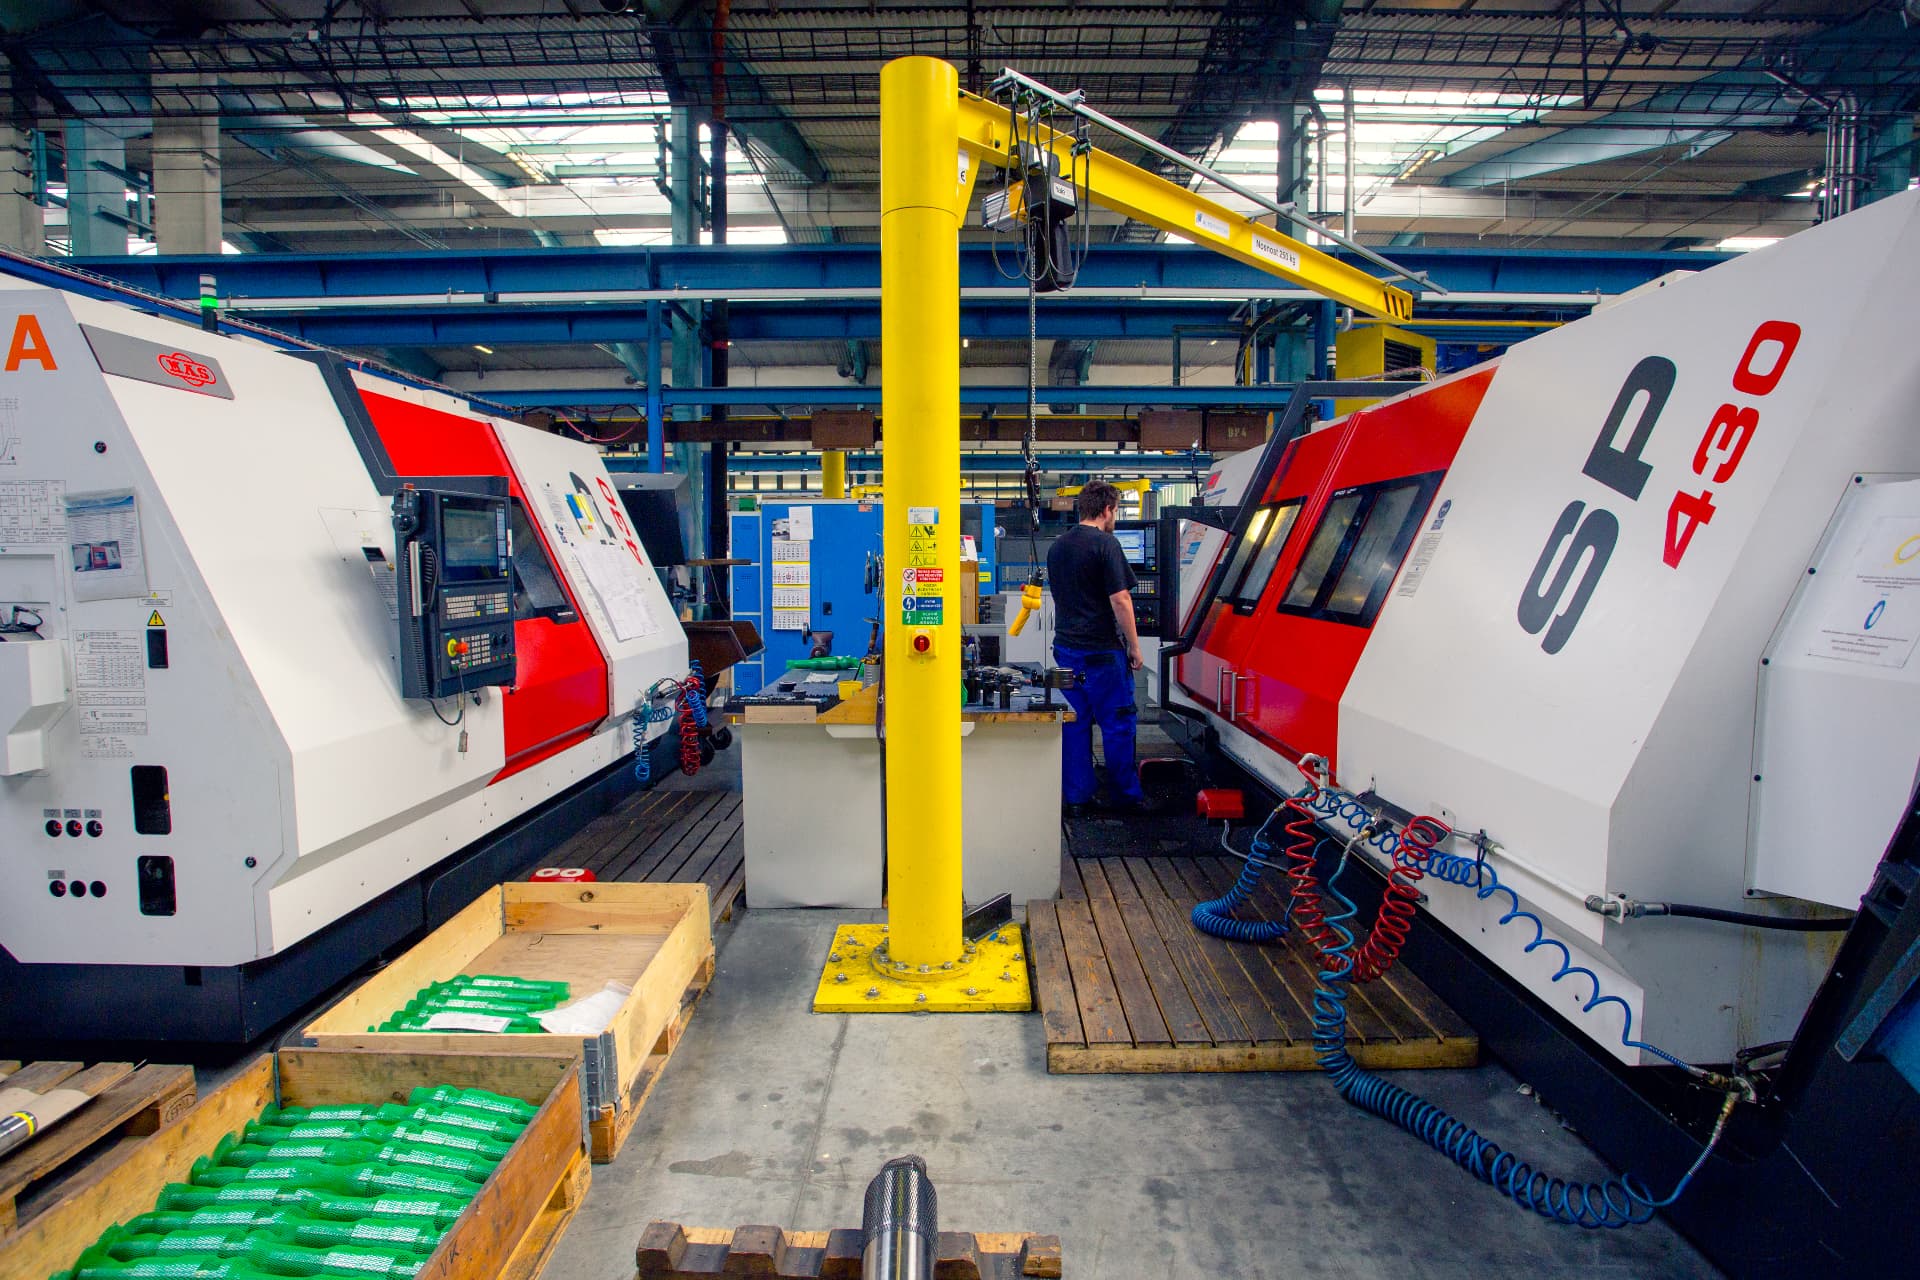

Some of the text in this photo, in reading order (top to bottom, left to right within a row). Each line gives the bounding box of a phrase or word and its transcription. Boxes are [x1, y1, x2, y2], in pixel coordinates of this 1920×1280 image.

[1256, 239, 1296, 266] Nosnost 250 kg
[5, 314, 58, 371] A
[1662, 320, 1802, 570] 430
[596, 476, 643, 566] 430
[1517, 355, 1677, 655] SP
